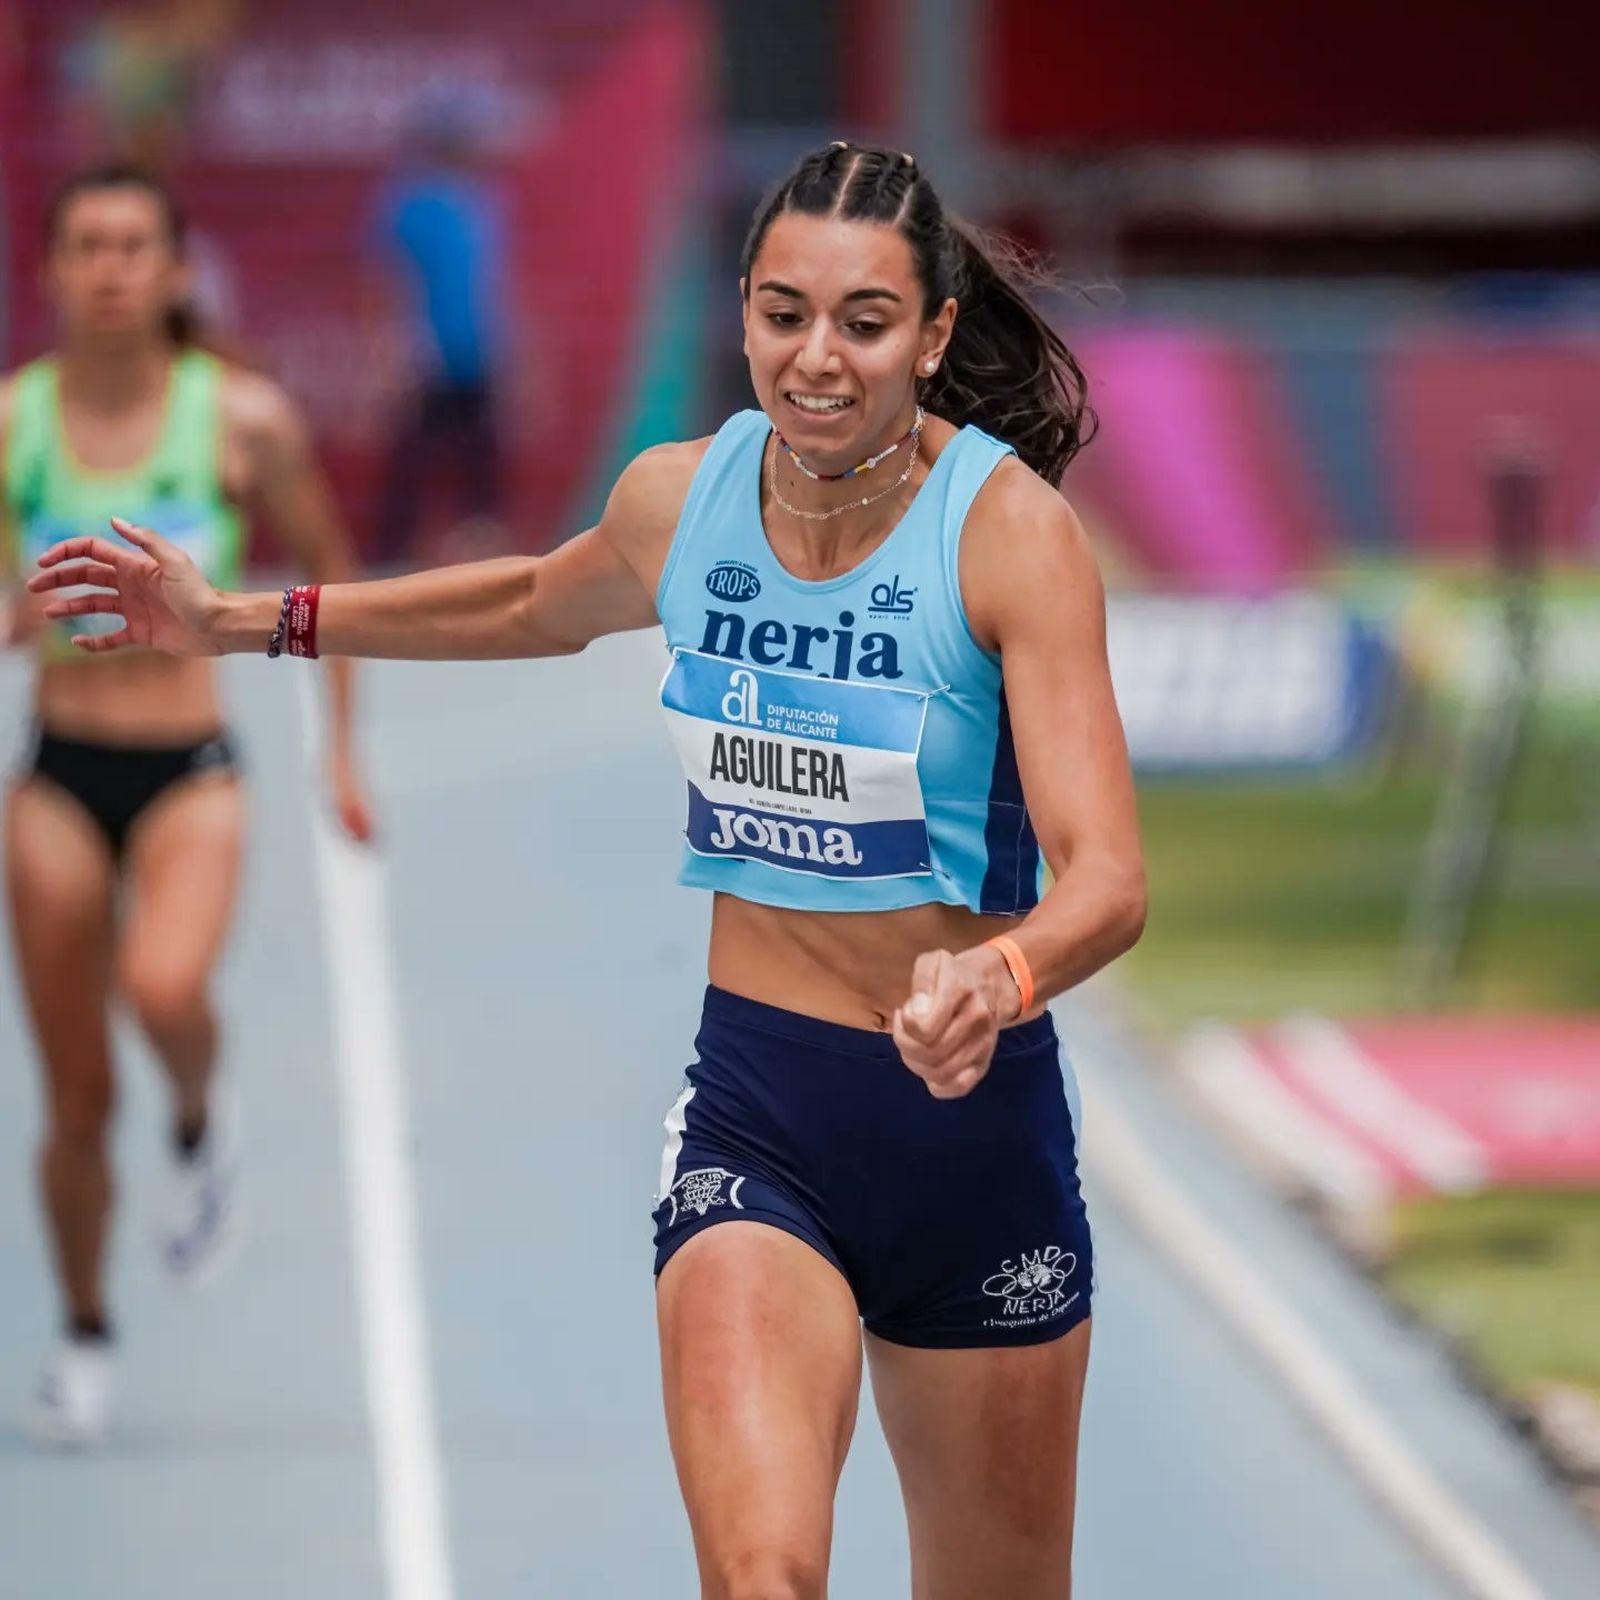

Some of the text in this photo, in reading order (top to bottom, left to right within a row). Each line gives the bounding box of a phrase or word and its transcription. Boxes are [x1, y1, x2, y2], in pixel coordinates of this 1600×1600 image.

[709, 569, 758, 597] TROPS
[868, 574, 914, 613] als
[698, 609, 903, 681] nerja
[767, 704, 839, 726] DIPUTACIÓN
[767, 718, 838, 739] DE ALICANTE
[709, 732, 850, 802] AGUILERA
[1003, 1289, 1065, 1315] NERJA
